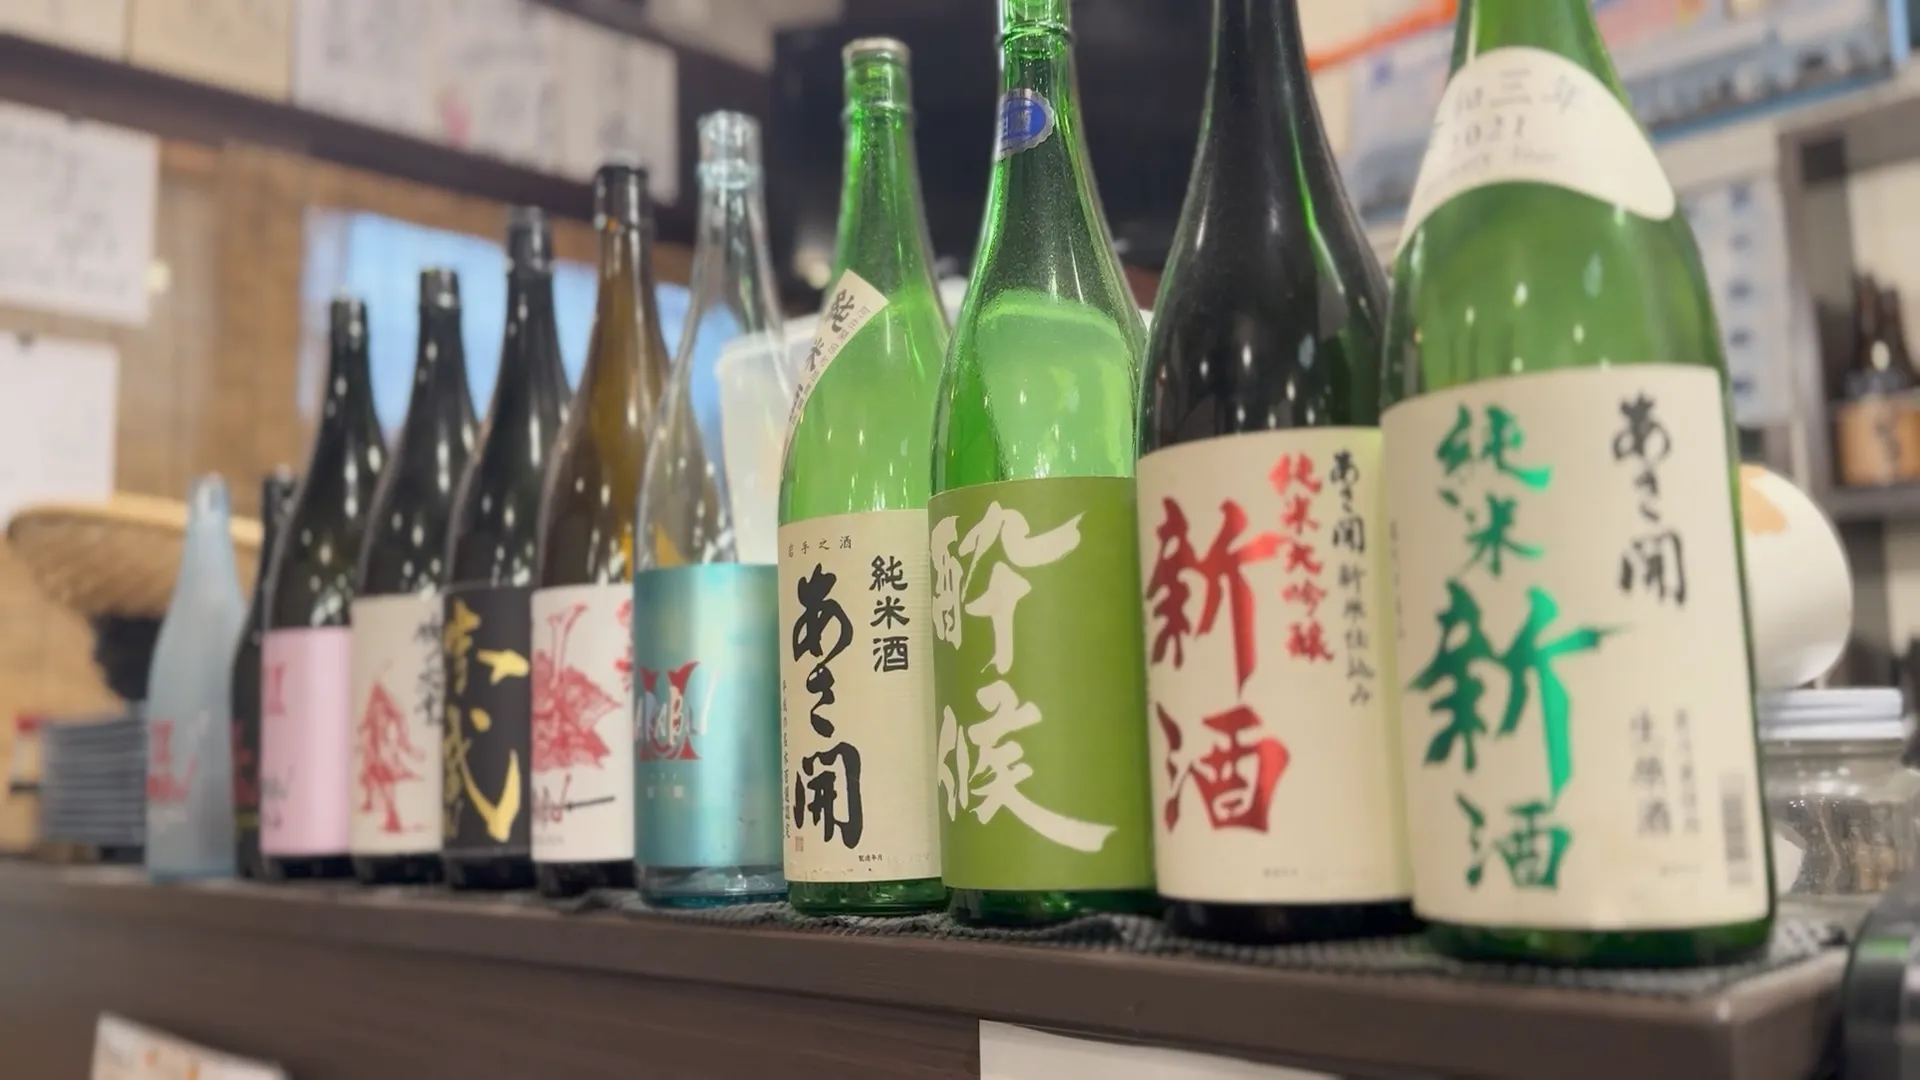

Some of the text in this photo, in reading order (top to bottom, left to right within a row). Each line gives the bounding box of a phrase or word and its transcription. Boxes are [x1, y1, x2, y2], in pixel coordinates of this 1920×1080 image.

[869, 555, 910, 672] 純米酒
[1612, 393, 1688, 608] あさ開
[792, 562, 863, 850] あさ開
[1146, 496, 1291, 833] 新酒
